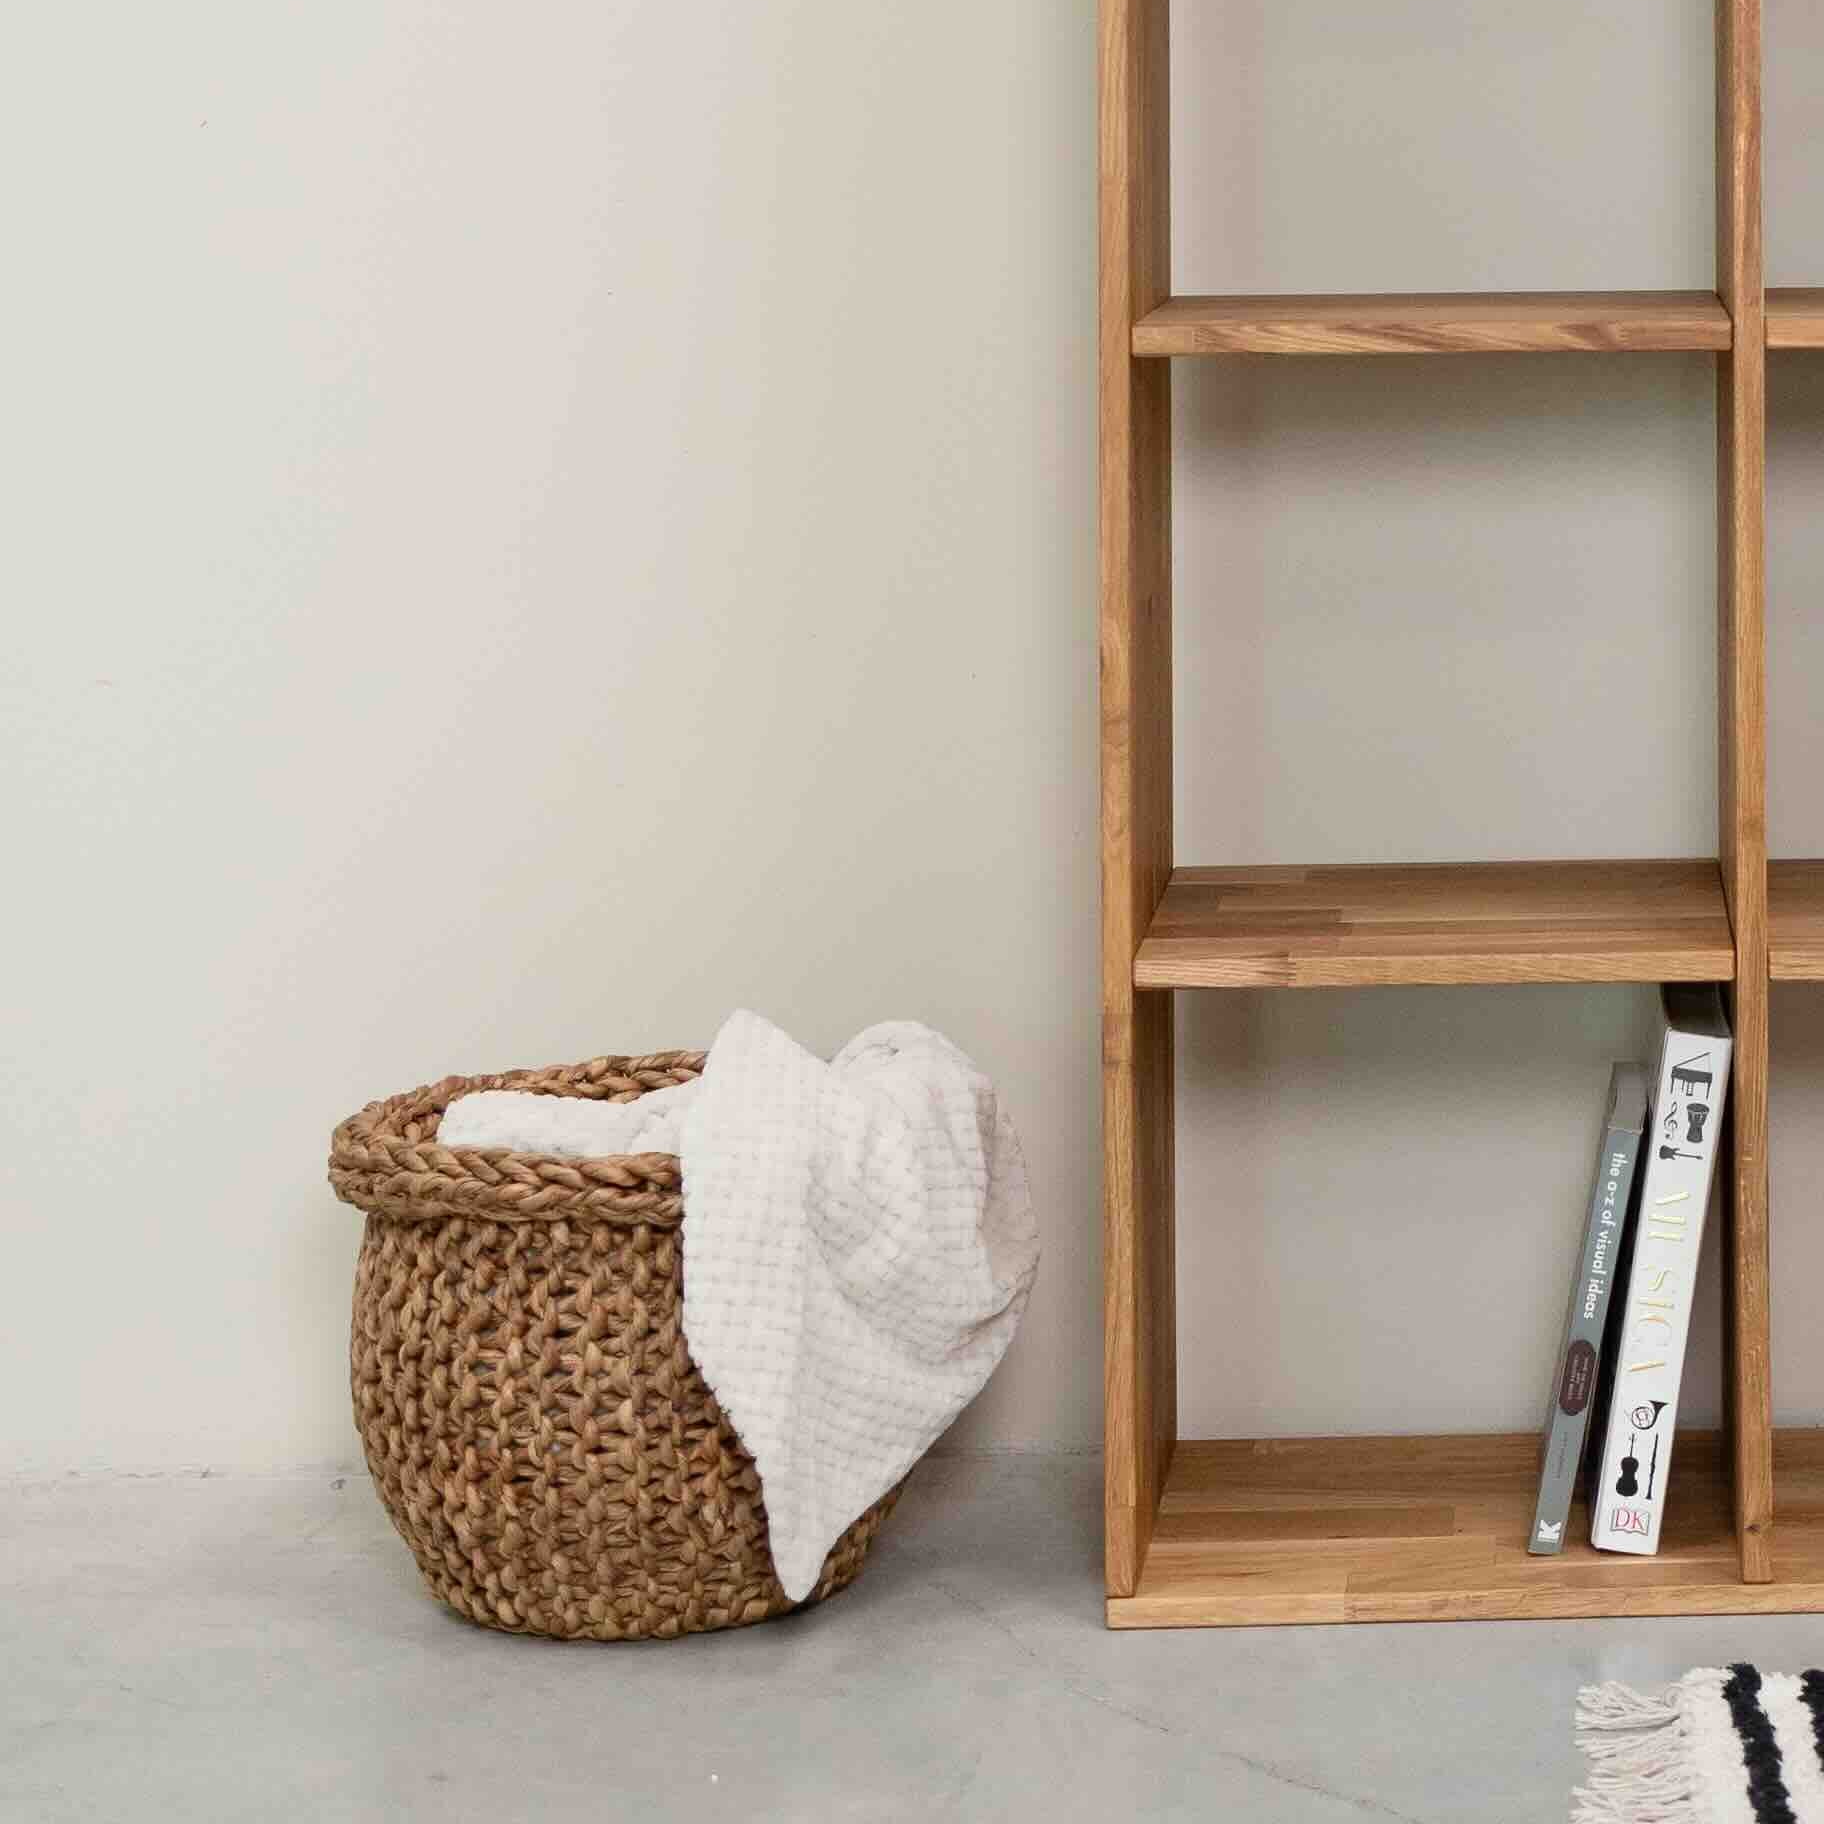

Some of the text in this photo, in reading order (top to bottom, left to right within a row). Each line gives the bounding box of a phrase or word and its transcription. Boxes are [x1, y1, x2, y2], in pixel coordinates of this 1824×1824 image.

[1583, 1152, 1628, 1320] the a-z of visual ideas
[1615, 1507, 1646, 1531] DK
